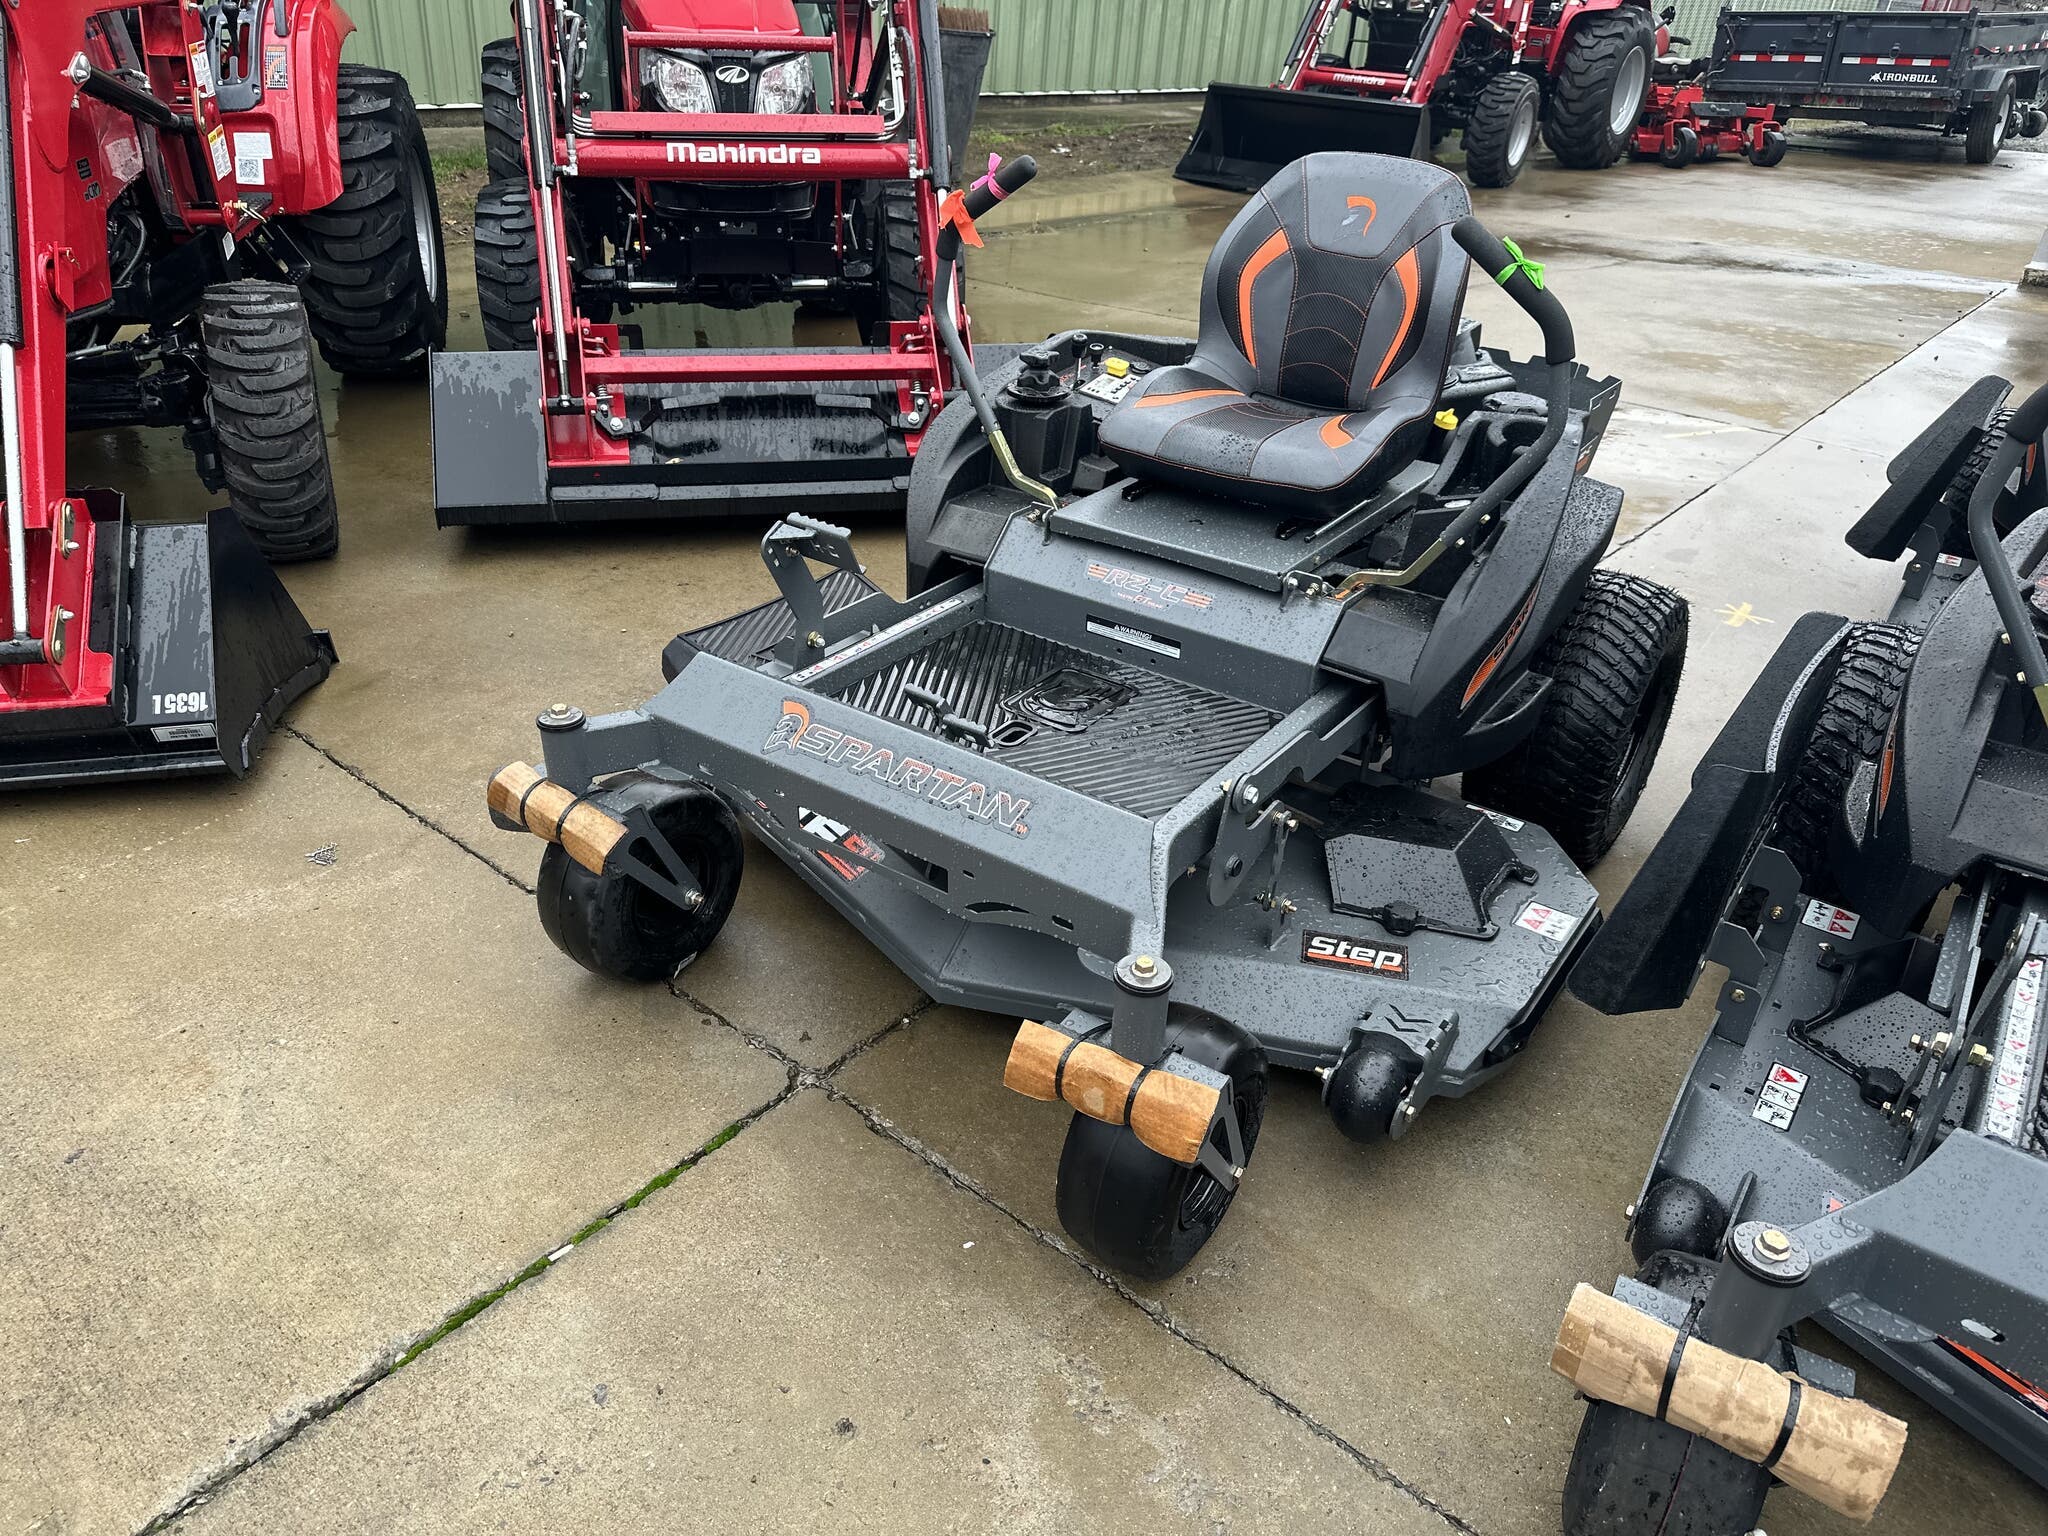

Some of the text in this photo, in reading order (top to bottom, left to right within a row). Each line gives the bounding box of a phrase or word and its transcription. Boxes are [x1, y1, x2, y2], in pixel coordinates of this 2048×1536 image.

[1333, 73, 1386, 86] Mahindra
[1882, 73, 1938, 84] IRONBULL
[666, 142, 821, 164] Mahindra
[1120, 625, 1153, 641] WARNING!
[797, 723, 1031, 828] SPARTAN
[1307, 936, 1403, 970] Step
